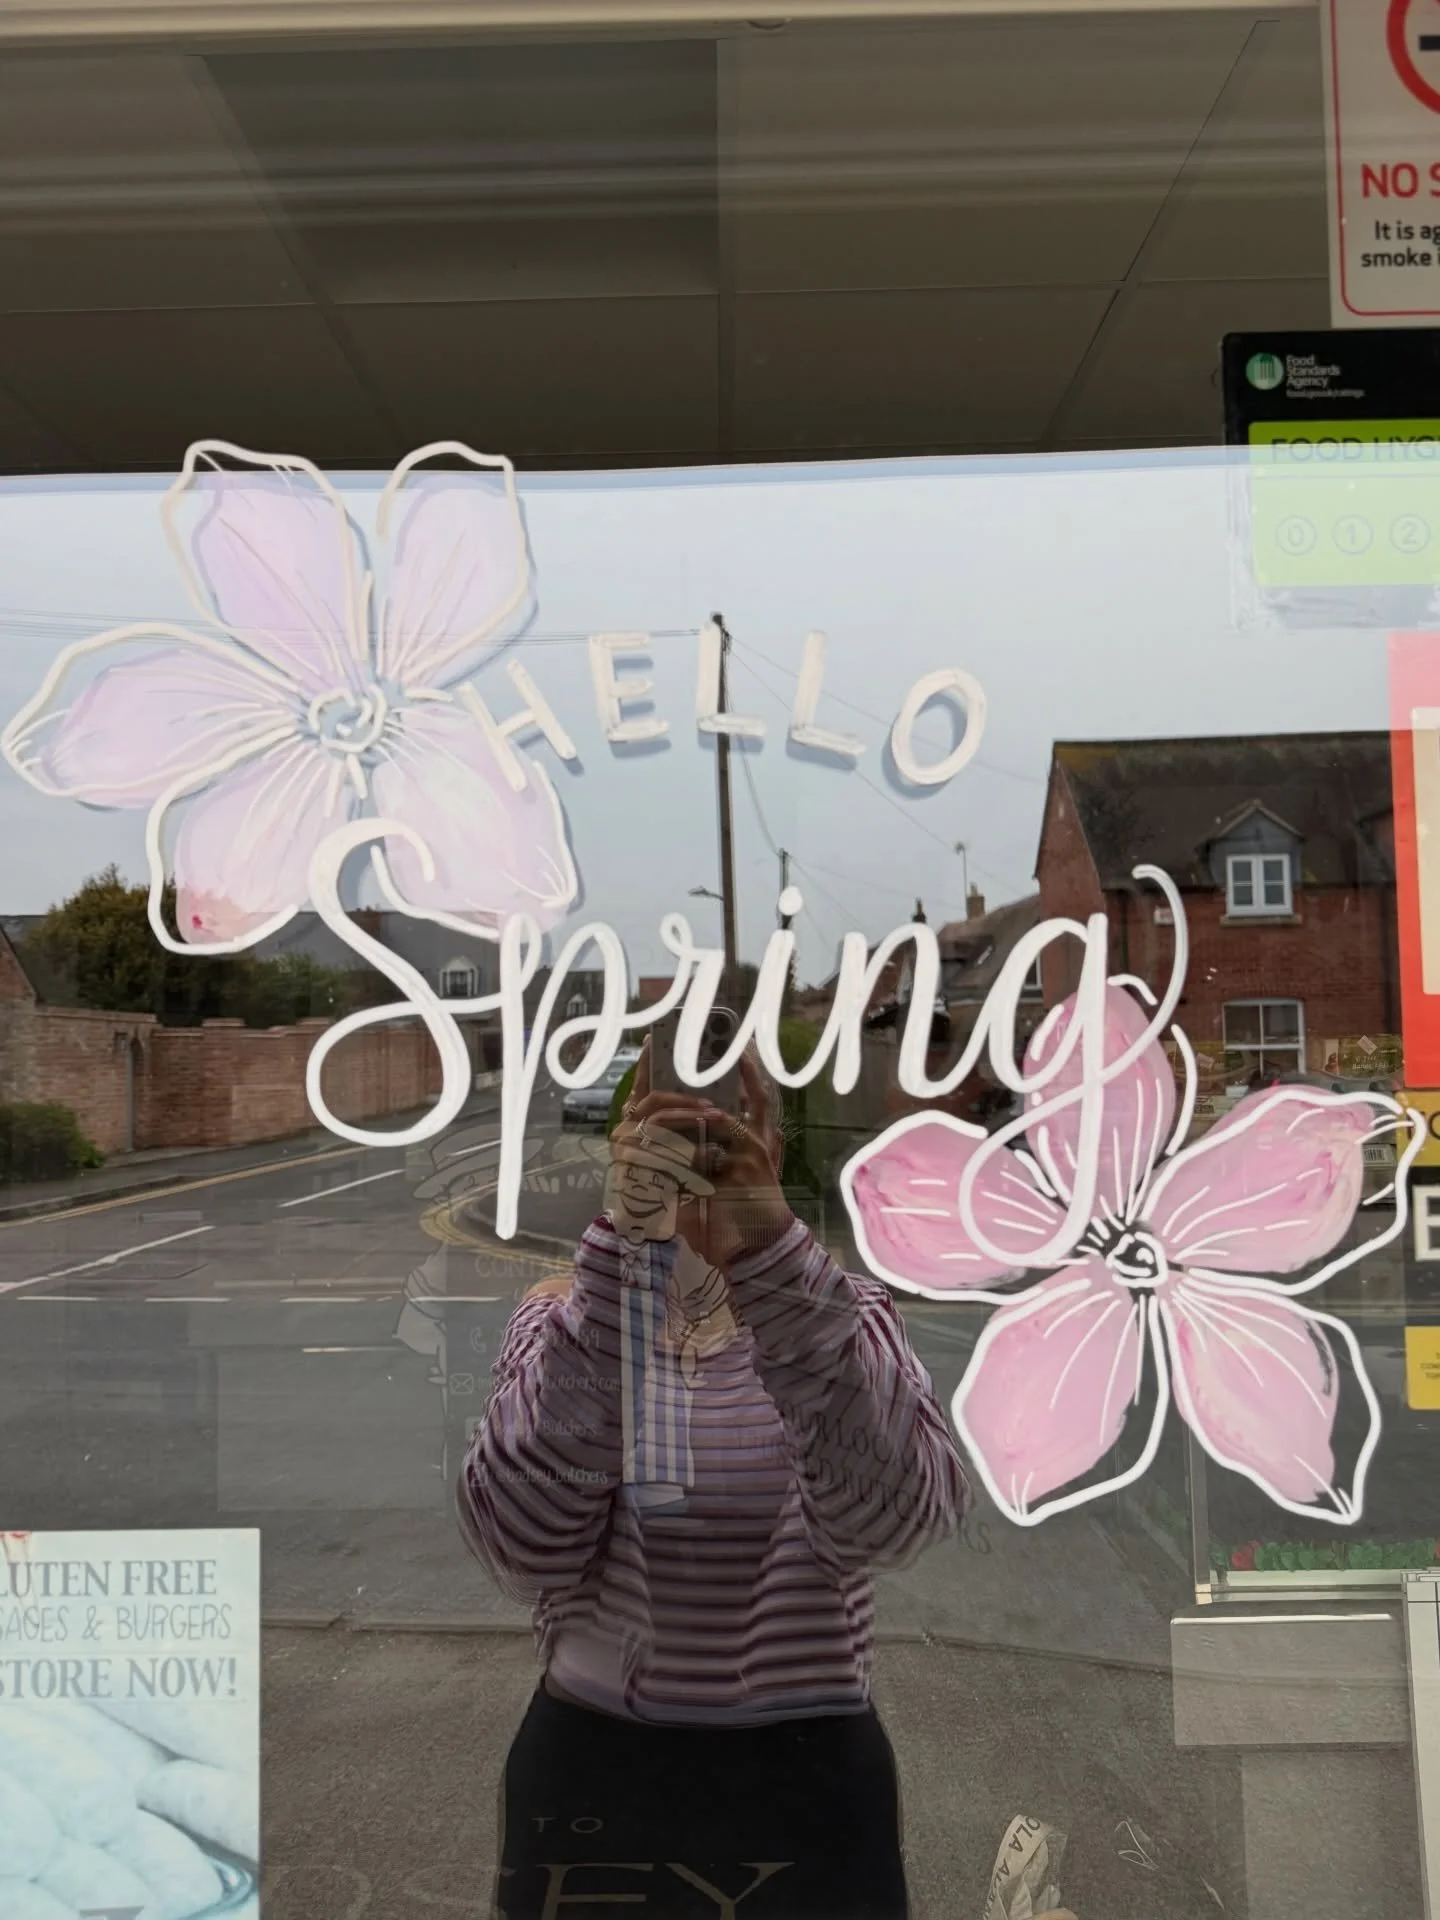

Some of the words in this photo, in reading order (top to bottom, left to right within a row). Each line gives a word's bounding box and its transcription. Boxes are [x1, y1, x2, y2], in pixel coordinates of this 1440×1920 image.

[1361, 162, 1418, 199] NO
[1375, 220, 1391, 240] It
[1397, 220, 1415, 240] is
[1361, 247, 1432, 268] smoke
[1286, 354, 1315, 367] Food
[1286, 366, 1341, 377] Standards
[1286, 377, 1329, 390] Agency
[1270, 436, 1364, 462] FOOD
[1372, 434, 1440, 462] HYG
[460, 622, 987, 792] HELLO
[306, 817, 1189, 1268] Spring
[0, 1560, 110, 1598] UTEN
[121, 1559, 217, 1597] FREE
[0, 1605, 70, 1642] AGES
[82, 1605, 101, 1641] &
[117, 1603, 233, 1642] BURGERS
[0, 1658, 112, 1699] TORE
[128, 1656, 237, 1698] NOW!
[532, 1816, 603, 1834] TO
